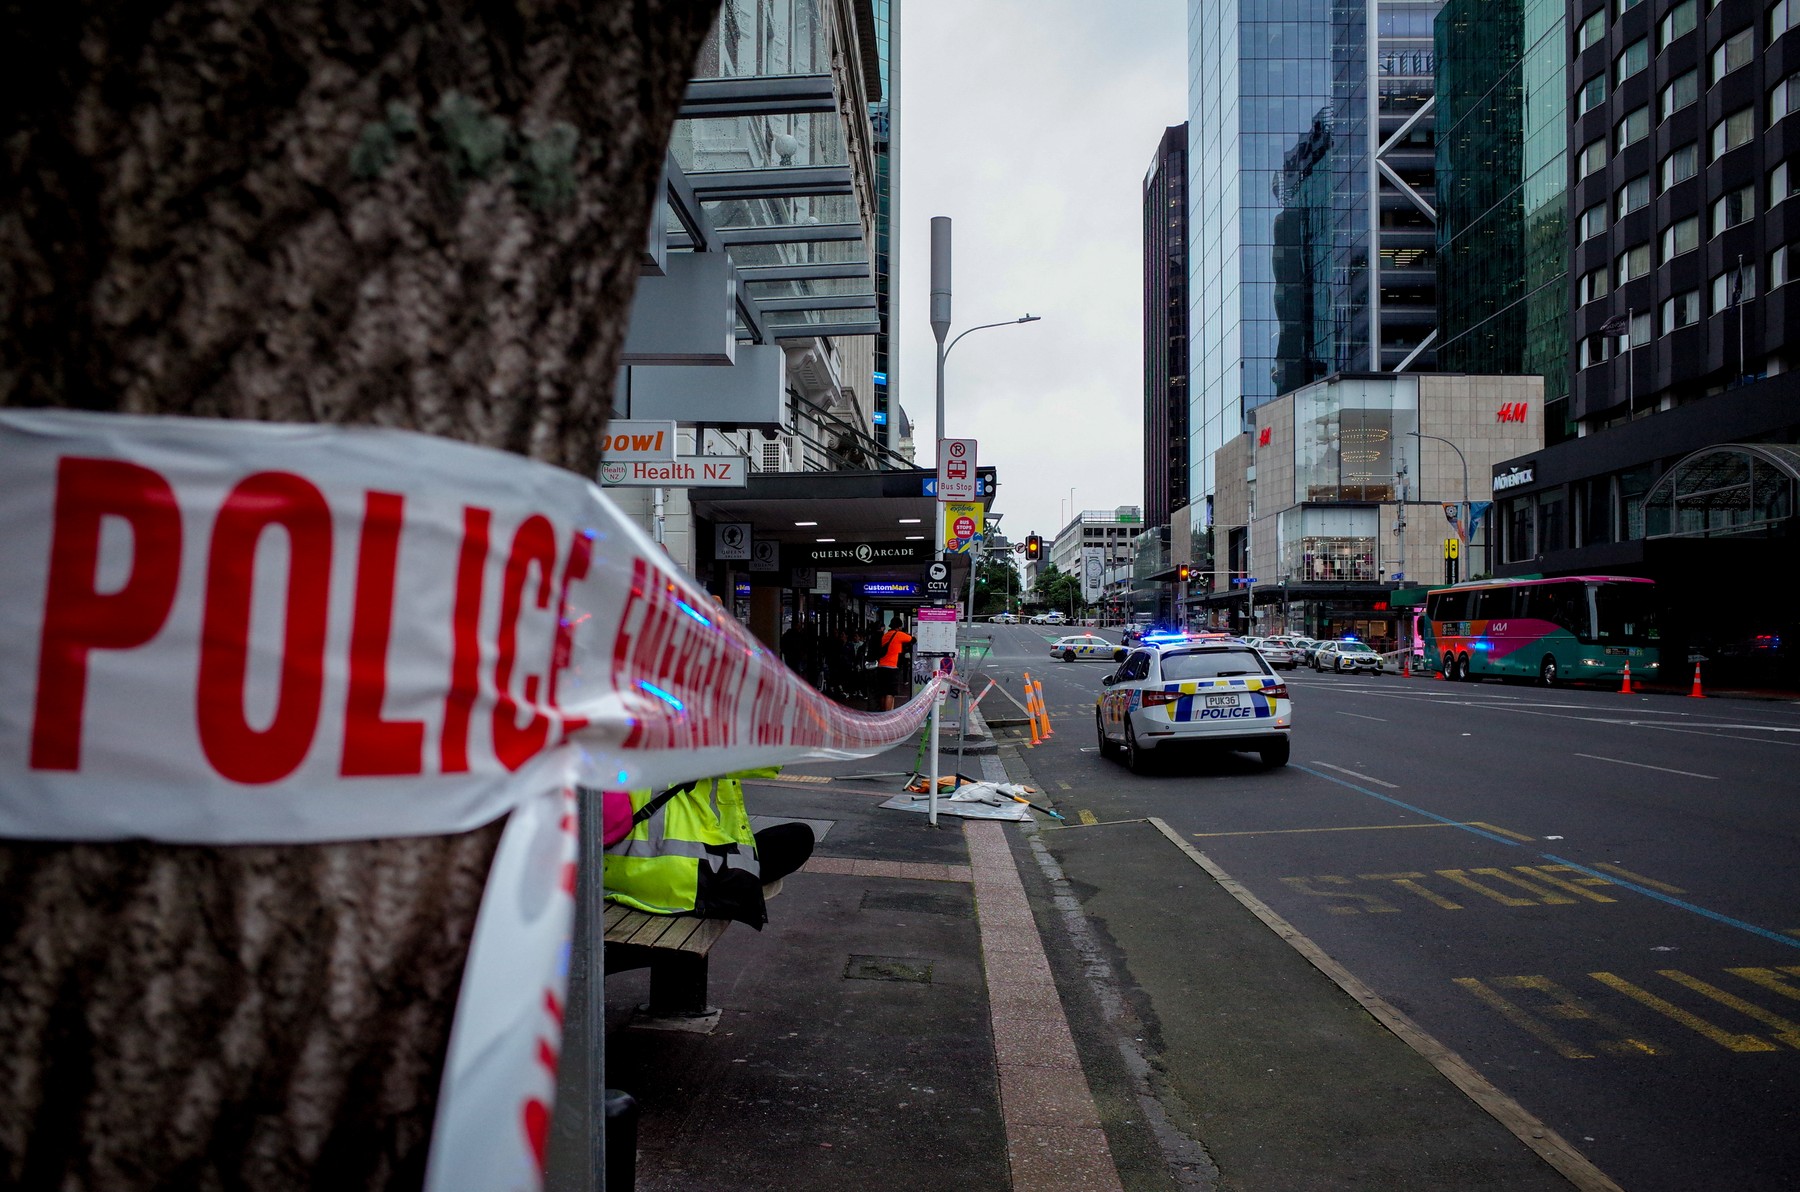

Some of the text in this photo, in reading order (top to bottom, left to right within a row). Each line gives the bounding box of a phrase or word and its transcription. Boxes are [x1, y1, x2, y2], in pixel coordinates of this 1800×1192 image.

[1496, 402, 1528, 423] H&M
[633, 462, 731, 480] Health NZ
[956, 483, 973, 492] Stop
[811, 550, 854, 559] QUEENS
[873, 548, 914, 557] ARCADE
[927, 581, 948, 589] CCTV
[29, 456, 593, 785] POLICE
[1209, 695, 1236, 706] PUK36
[1200, 707, 1251, 719] POLICE
[1278, 864, 1618, 914] STOP
